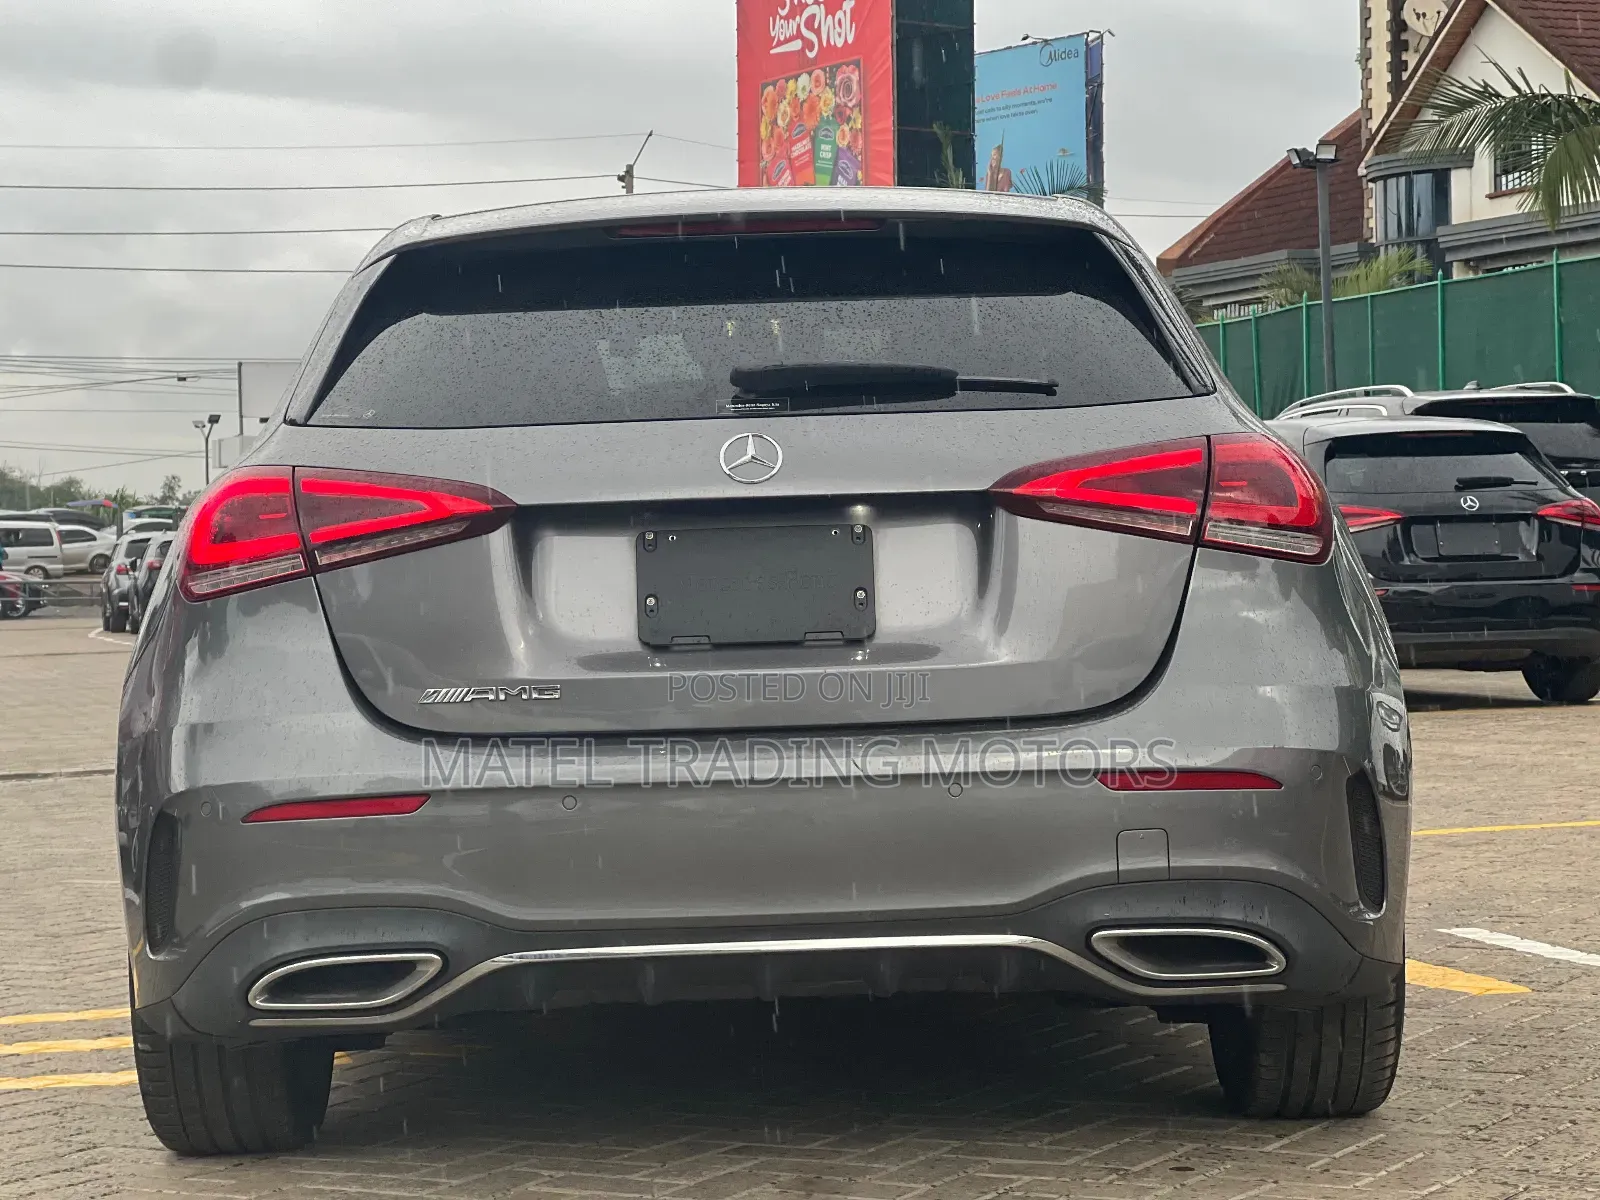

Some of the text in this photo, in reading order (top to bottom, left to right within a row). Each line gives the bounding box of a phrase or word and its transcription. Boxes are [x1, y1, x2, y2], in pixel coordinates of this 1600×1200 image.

[770, 0, 855, 58] your Shot
[1039, 43, 1079, 67] Midea
[981, 92, 1000, 103] Love
[1023, 86, 1033, 95] At
[1033, 82, 1057, 94] Home
[464, 684, 561, 702] AMG
